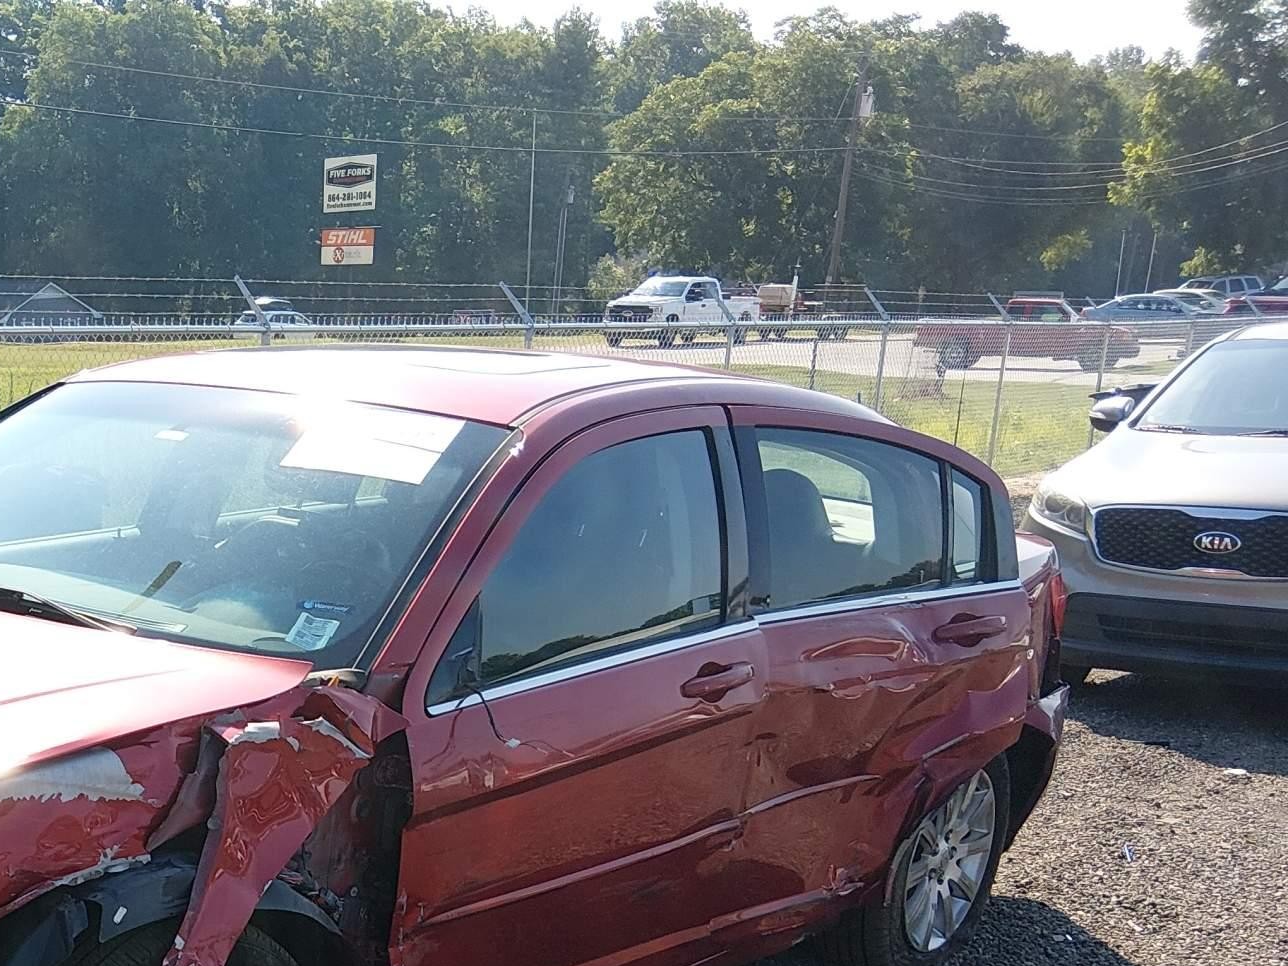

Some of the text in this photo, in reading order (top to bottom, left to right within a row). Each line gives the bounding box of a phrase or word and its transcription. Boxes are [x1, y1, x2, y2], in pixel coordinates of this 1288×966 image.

[329, 167, 371, 178] FIVE FORKS
[326, 230, 368, 243] STIHL
[1200, 536, 1232, 550] KIA
